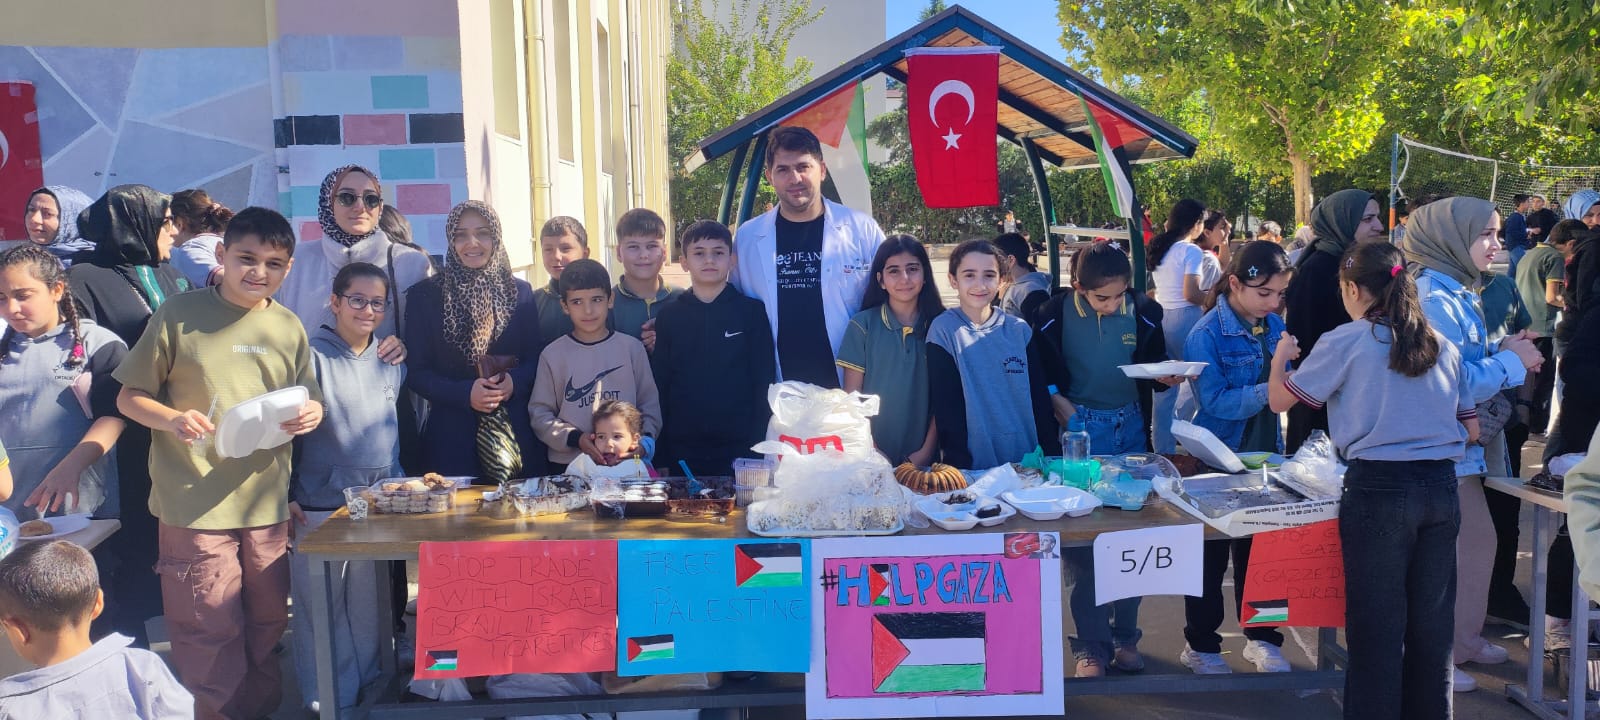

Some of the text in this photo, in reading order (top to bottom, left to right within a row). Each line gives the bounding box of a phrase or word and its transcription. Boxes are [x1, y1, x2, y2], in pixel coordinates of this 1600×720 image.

[793, 251, 822, 265] JEAN
[1263, 528, 1311, 545] STOP
[1120, 545, 1174, 576] 5/B
[1299, 543, 1339, 556] GAZ
[434, 554, 594, 580] STOP TRADE
[643, 552, 720, 576] FREE
[439, 583, 611, 608] WITH ISRAEL
